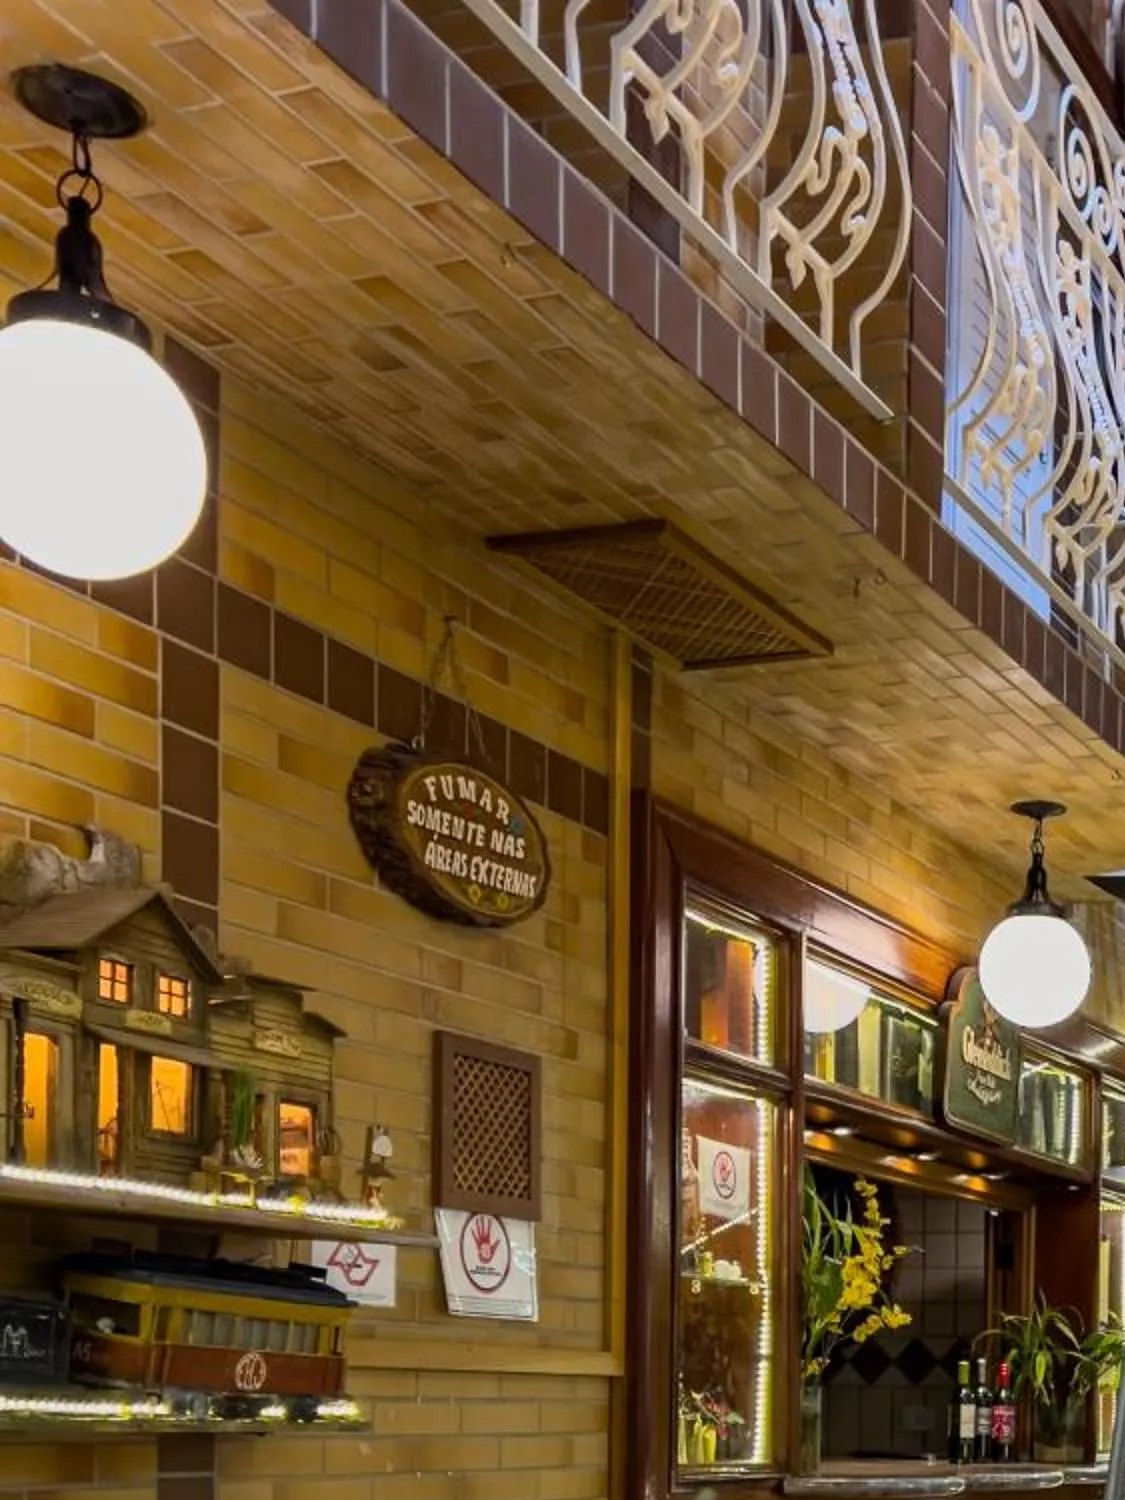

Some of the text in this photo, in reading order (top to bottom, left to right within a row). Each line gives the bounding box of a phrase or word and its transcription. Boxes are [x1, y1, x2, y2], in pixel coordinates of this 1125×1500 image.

[407, 800, 527, 859] SOMENTE NAS
[424, 775, 511, 825] FUMAR
[424, 832, 538, 898] ÁREAS EXTERNAS
